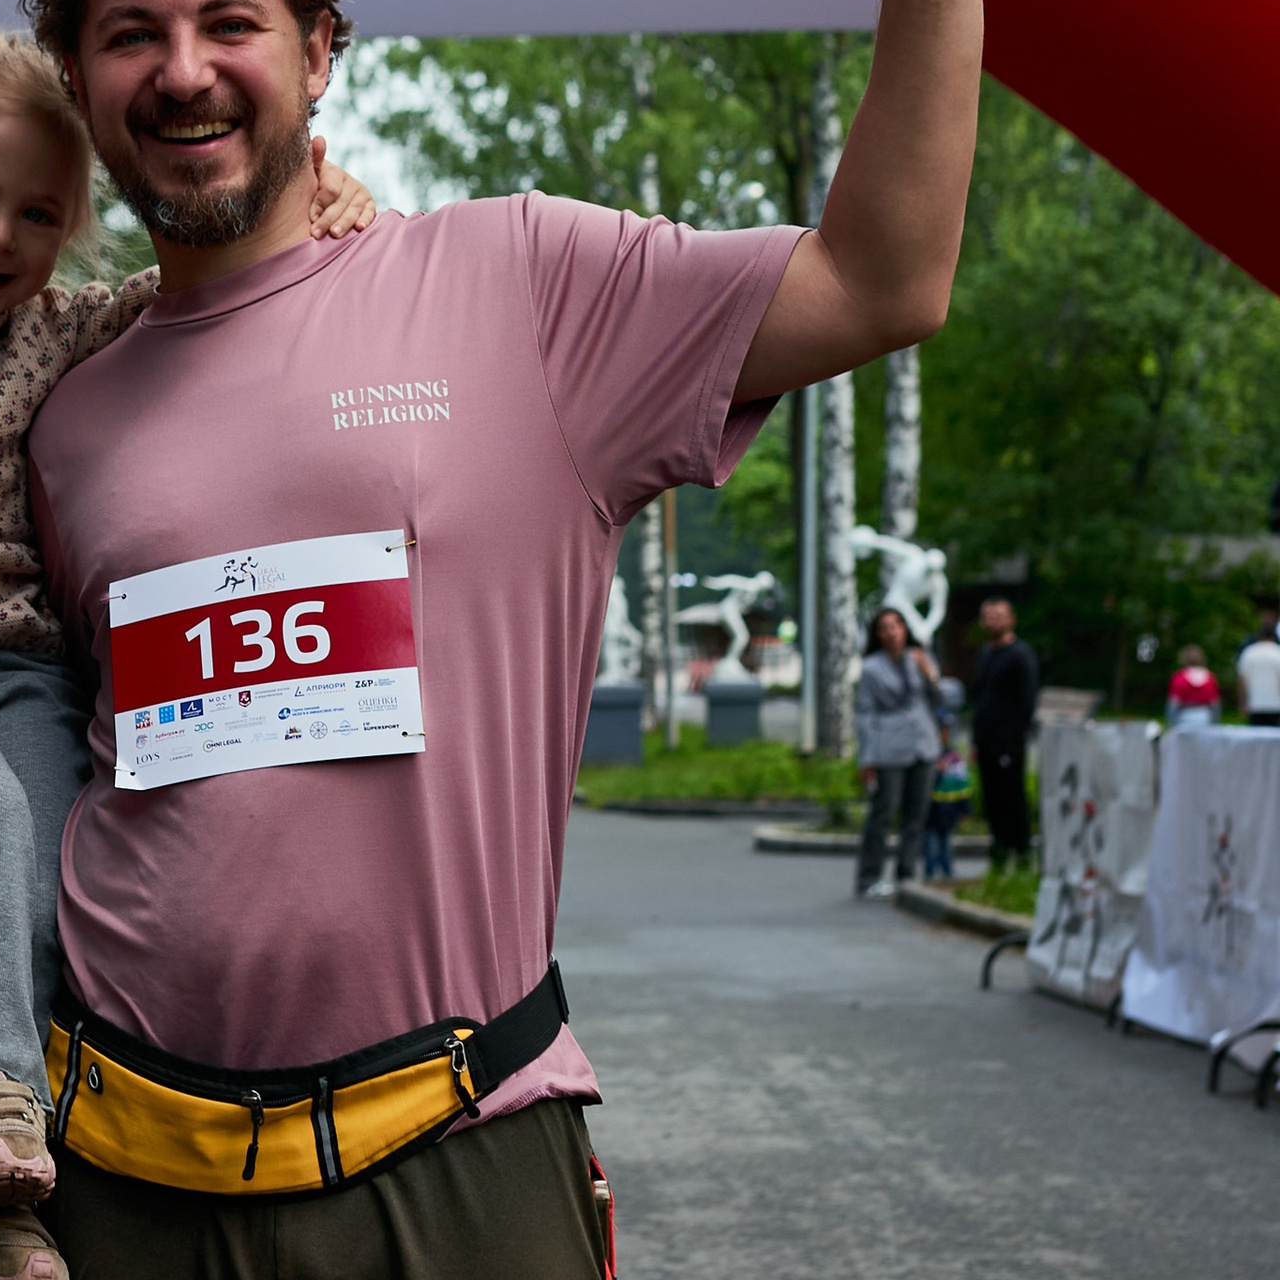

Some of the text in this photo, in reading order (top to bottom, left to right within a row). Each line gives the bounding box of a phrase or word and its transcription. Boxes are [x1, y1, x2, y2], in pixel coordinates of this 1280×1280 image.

[331, 379, 449, 409] RUNNING
[333, 402, 450, 430] RELIGION
[185, 600, 331, 680] 136
[206, 738, 242, 749] OMNI LEGAL
